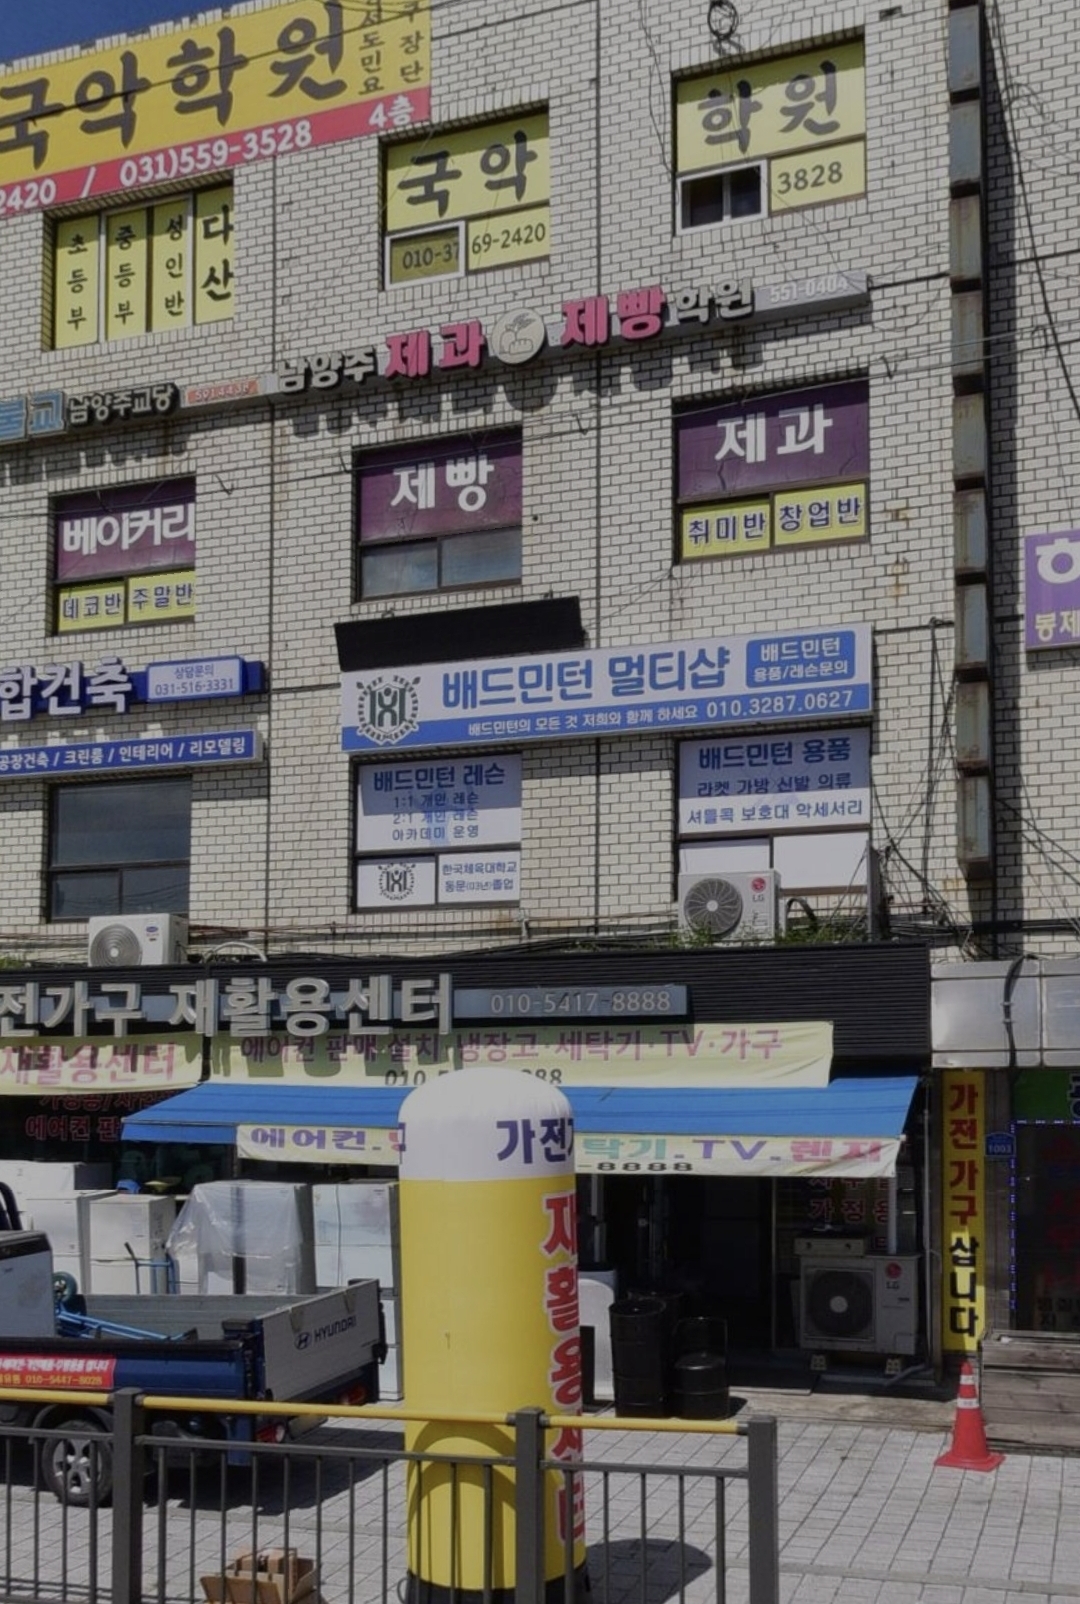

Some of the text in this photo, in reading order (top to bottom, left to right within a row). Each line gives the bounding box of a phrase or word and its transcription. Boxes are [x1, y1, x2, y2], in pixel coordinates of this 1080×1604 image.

[368, 95, 415, 128] 4층
[697, 60, 841, 153] 학원
[119, 121, 313, 187] 031)559-3528
[397, 130, 537, 217] 국악
[777, 161, 843, 194] 3828
[202, 204, 233, 301] 다산
[471, 223, 546, 255] 69-2420
[278, 348, 375, 393] 남양주
[385, 319, 485, 378] 제과
[714, 404, 833, 463] 제과
[390, 454, 494, 512] 제빵
[62, 503, 195, 555] 베이커리
[688, 497, 860, 544] 취미반 창업반
[63, 583, 193, 619] 데코반 주말반
[760, 637, 841, 662] 배드민턴
[154, 679, 235, 696] 031-516-3331
[442, 646, 731, 710] 배드민턴 멀티샵
[468, 718, 531, 737] 배드민턴의
[534, 716, 561, 732] 모든
[565, 714, 579, 730] 것
[626, 709, 654, 725] 함께
[657, 705, 699, 721] 하세요
[706, 689, 853, 719] 010.3287.0627
[120, 742, 174, 762] 인테리어
[189, 737, 246, 758] 리모델링
[699, 737, 852, 770] 배드민턴 용품
[373, 762, 506, 793] 배드민턴 레슨
[697, 771, 853, 797] 라켓 가방 신발 의류
[420, 792, 447, 808] 개인
[453, 791, 479, 805] 레슨
[452, 806, 479, 821] 레슨
[740, 803, 790, 822] 보호대
[796, 799, 863, 818] 악세서리
[392, 824, 480, 841] 아카데미 운영
[168, 972, 451, 1038] 재활용센터
[490, 990, 672, 1014] 010-5417-8888
[241, 1036, 316, 1063] 에어컨
[314, 1315, 357, 1342] HYUNDAI
